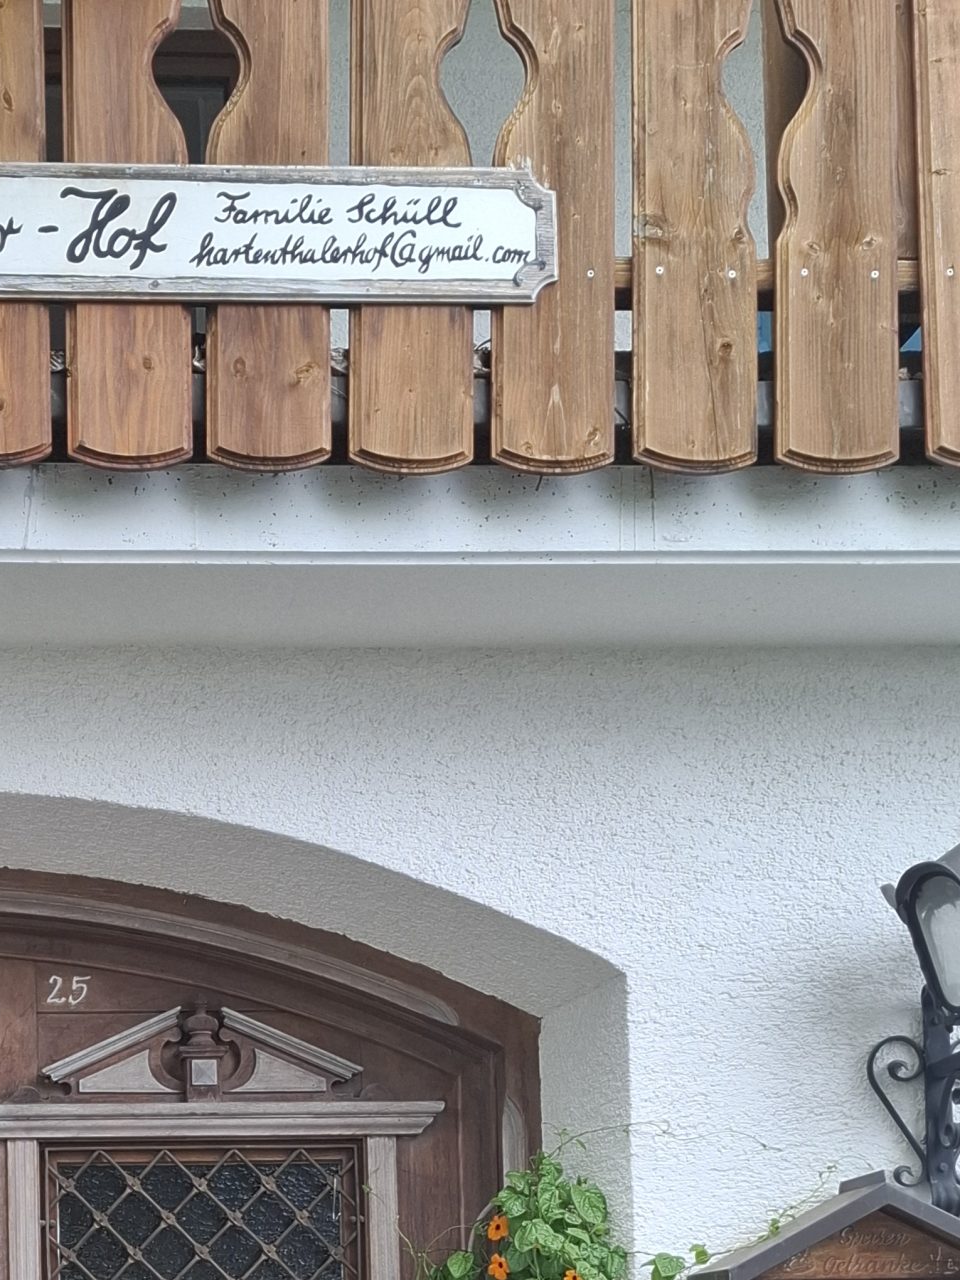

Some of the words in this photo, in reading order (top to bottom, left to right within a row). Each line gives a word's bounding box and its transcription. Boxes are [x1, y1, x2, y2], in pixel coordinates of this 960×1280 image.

[213, 191, 334, 226] Familie
[345, 193, 462, 228] Schüll
[59, 185, 178, 271] Hof
[46, 975, 91, 1005] 25
[839, 1225, 912, 1250] Speisen
